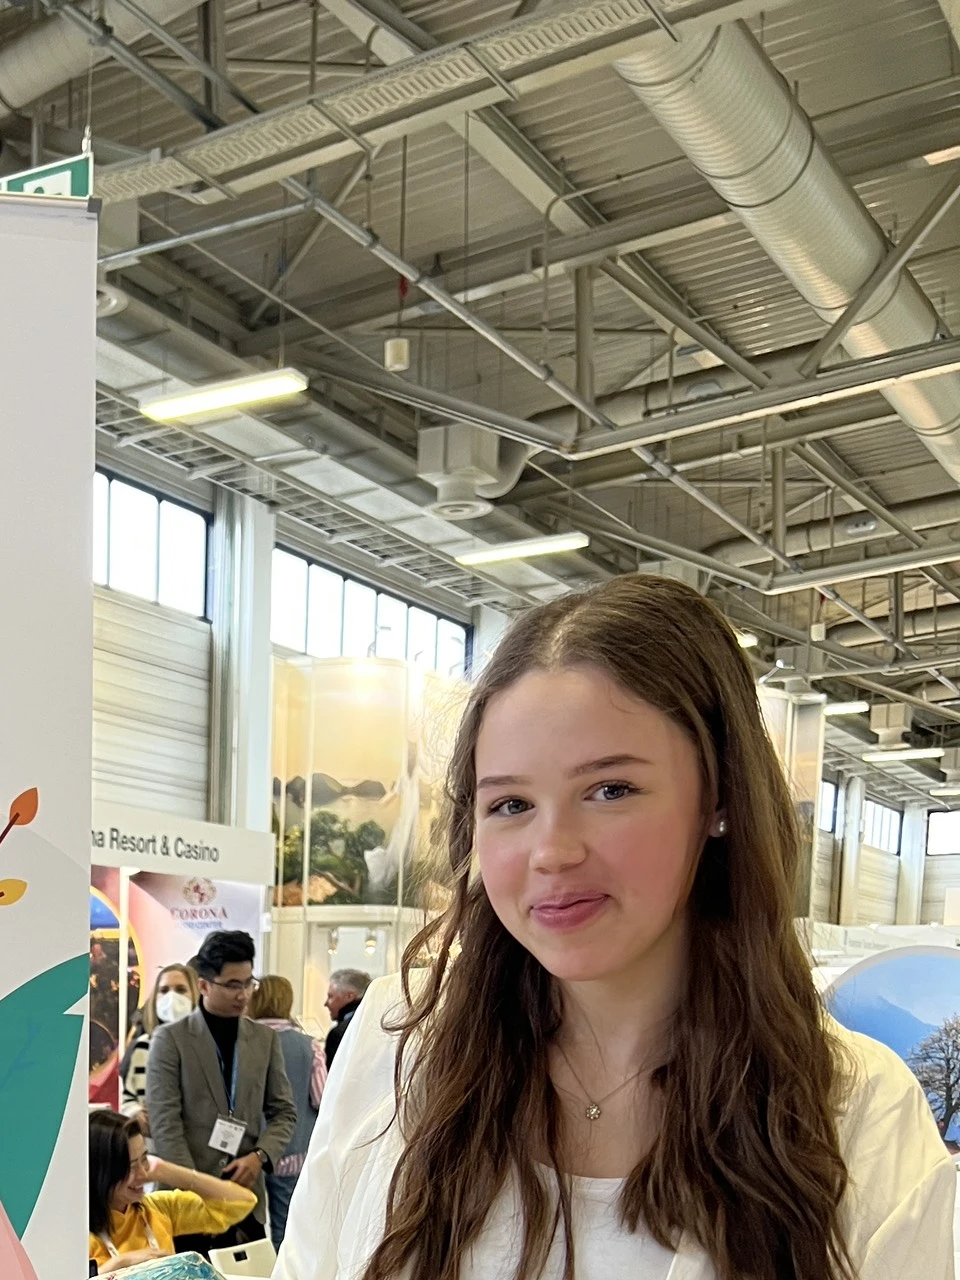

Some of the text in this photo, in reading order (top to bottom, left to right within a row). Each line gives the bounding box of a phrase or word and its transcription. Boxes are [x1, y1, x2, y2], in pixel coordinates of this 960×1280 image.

[110, 828, 156, 855] Resort
[160, 835, 170, 856] &
[174, 837, 219, 862] Casino
